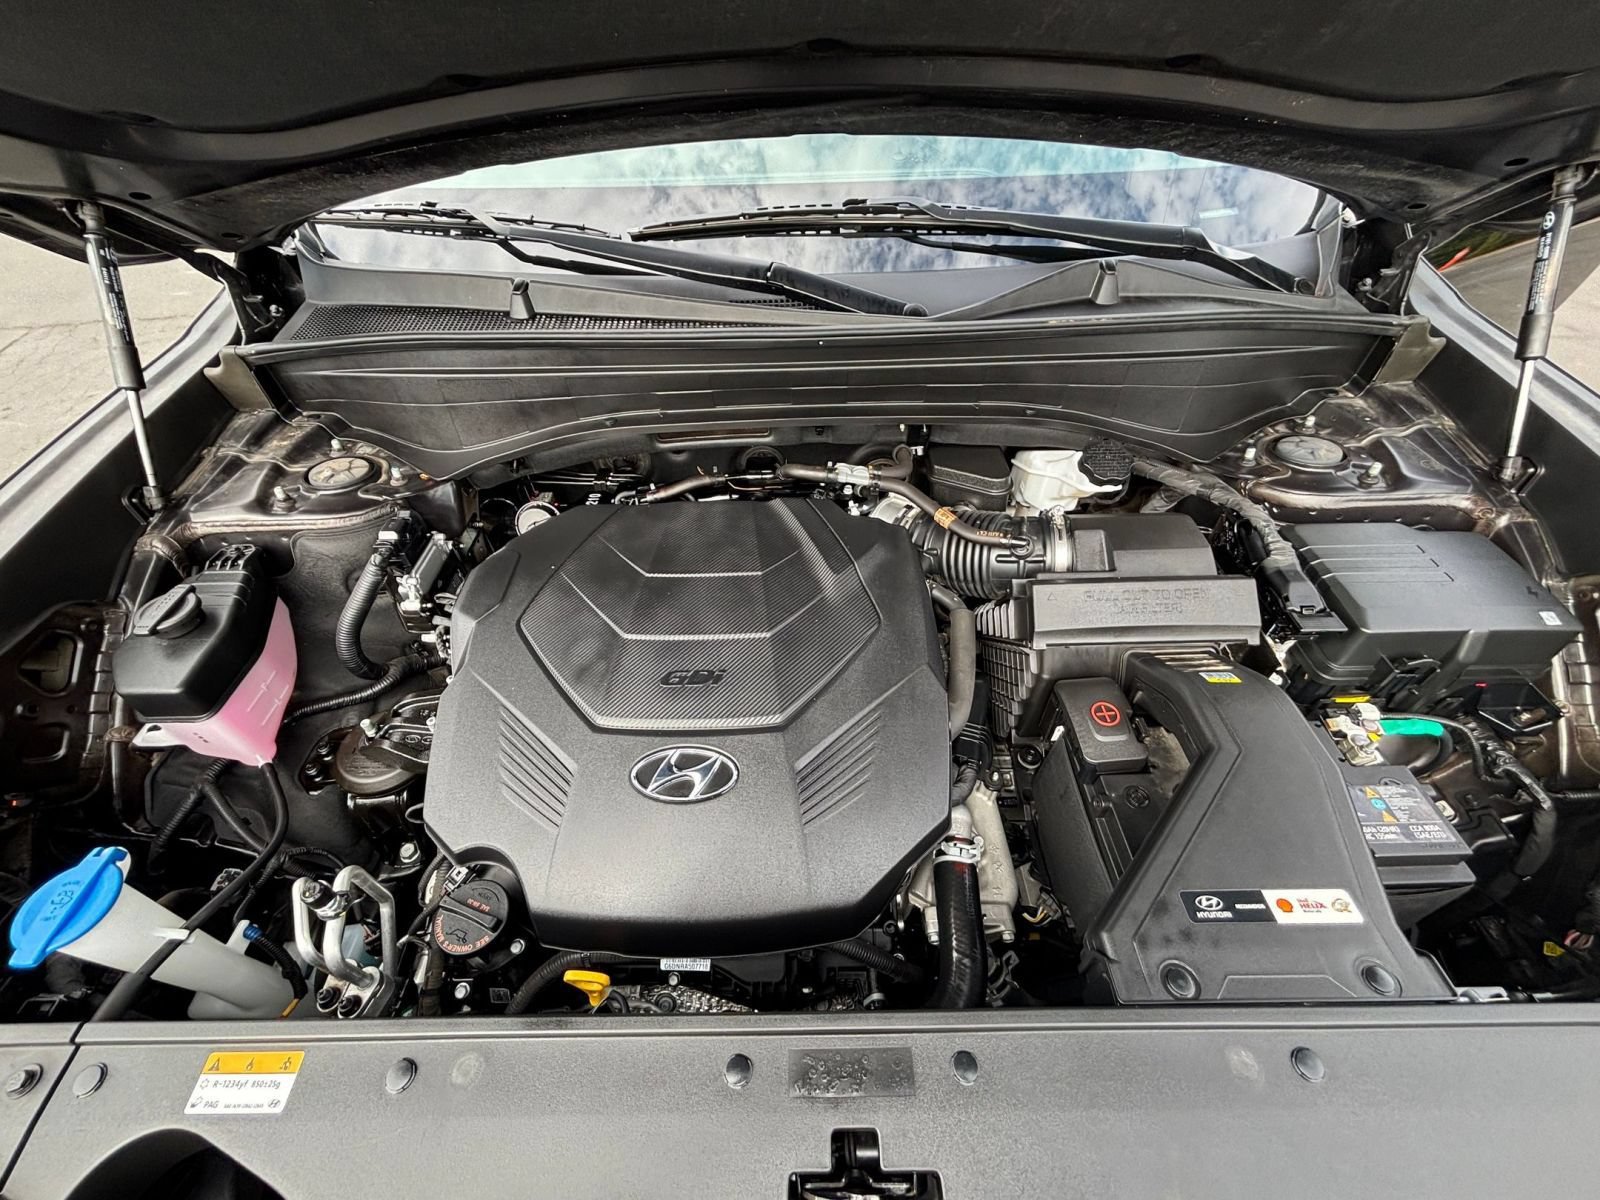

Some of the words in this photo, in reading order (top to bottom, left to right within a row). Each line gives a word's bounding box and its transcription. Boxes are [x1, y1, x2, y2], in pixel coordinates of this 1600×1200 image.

[1122, 590, 1149, 601] OUT
[1152, 589, 1171, 600] TO
[1174, 588, 1208, 600] OPEN
[660, 669, 727, 687] GDi
[442, 940, 473, 953] OWNER'S
[475, 935, 490, 948] SEE
[212, 1079, 248, 1090] R-1234yf
[203, 1100, 219, 1109] PAG
